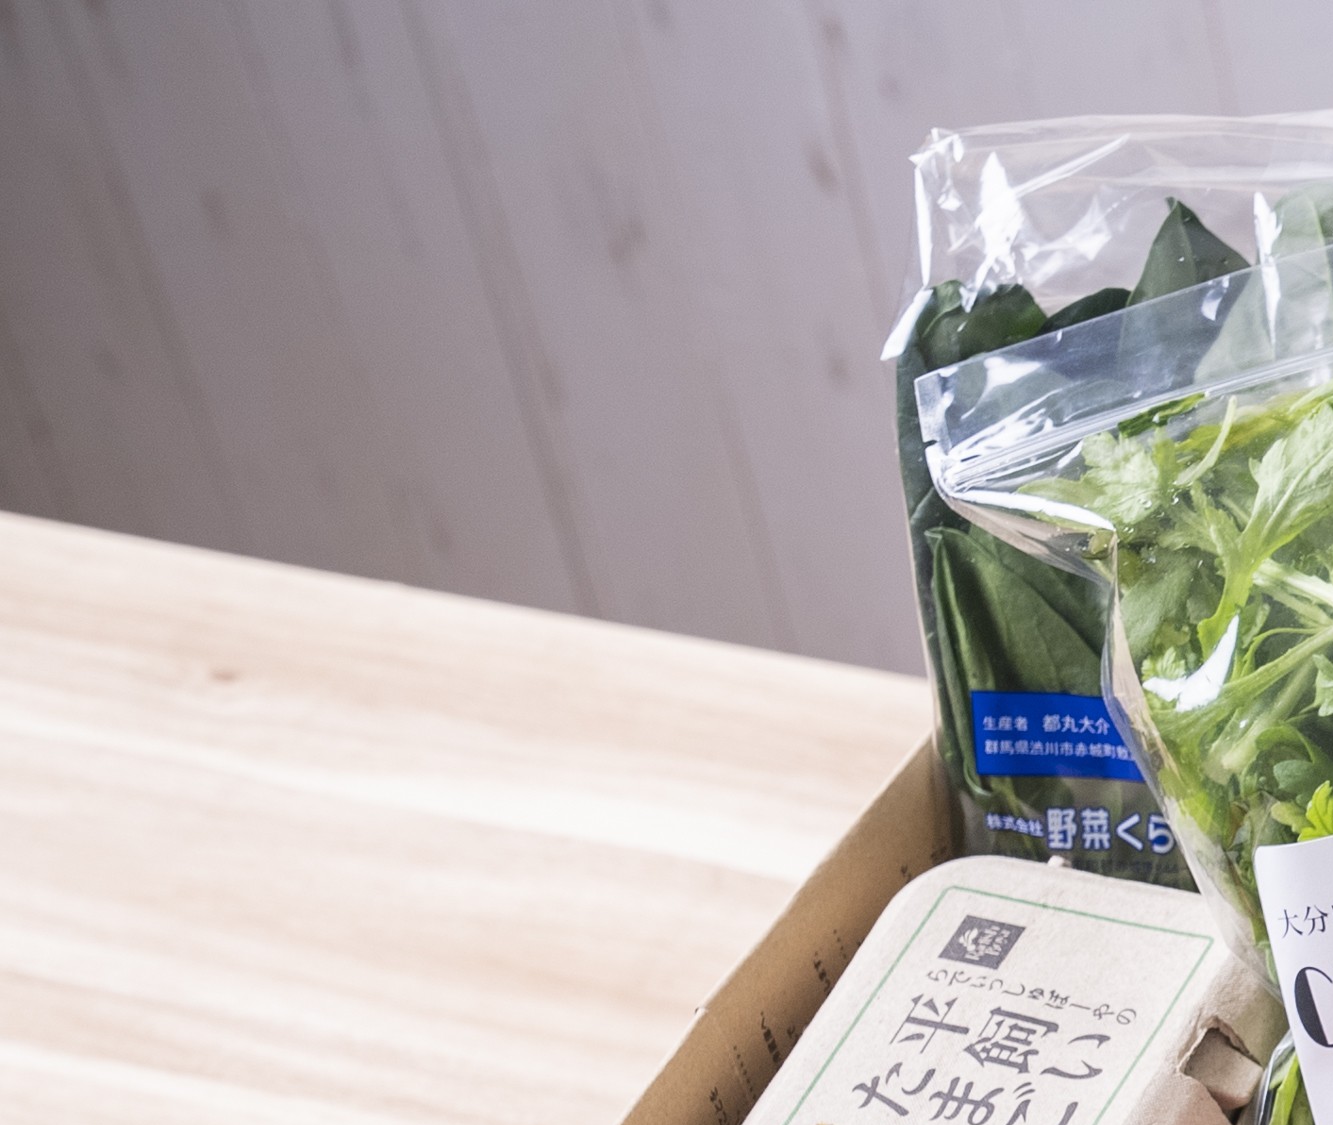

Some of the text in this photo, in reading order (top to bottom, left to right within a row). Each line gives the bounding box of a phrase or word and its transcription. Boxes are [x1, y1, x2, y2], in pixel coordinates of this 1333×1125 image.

[982, 714, 1110, 736] 生産者 都丸大介
[889, 992, 1113, 1082] 平飼い
